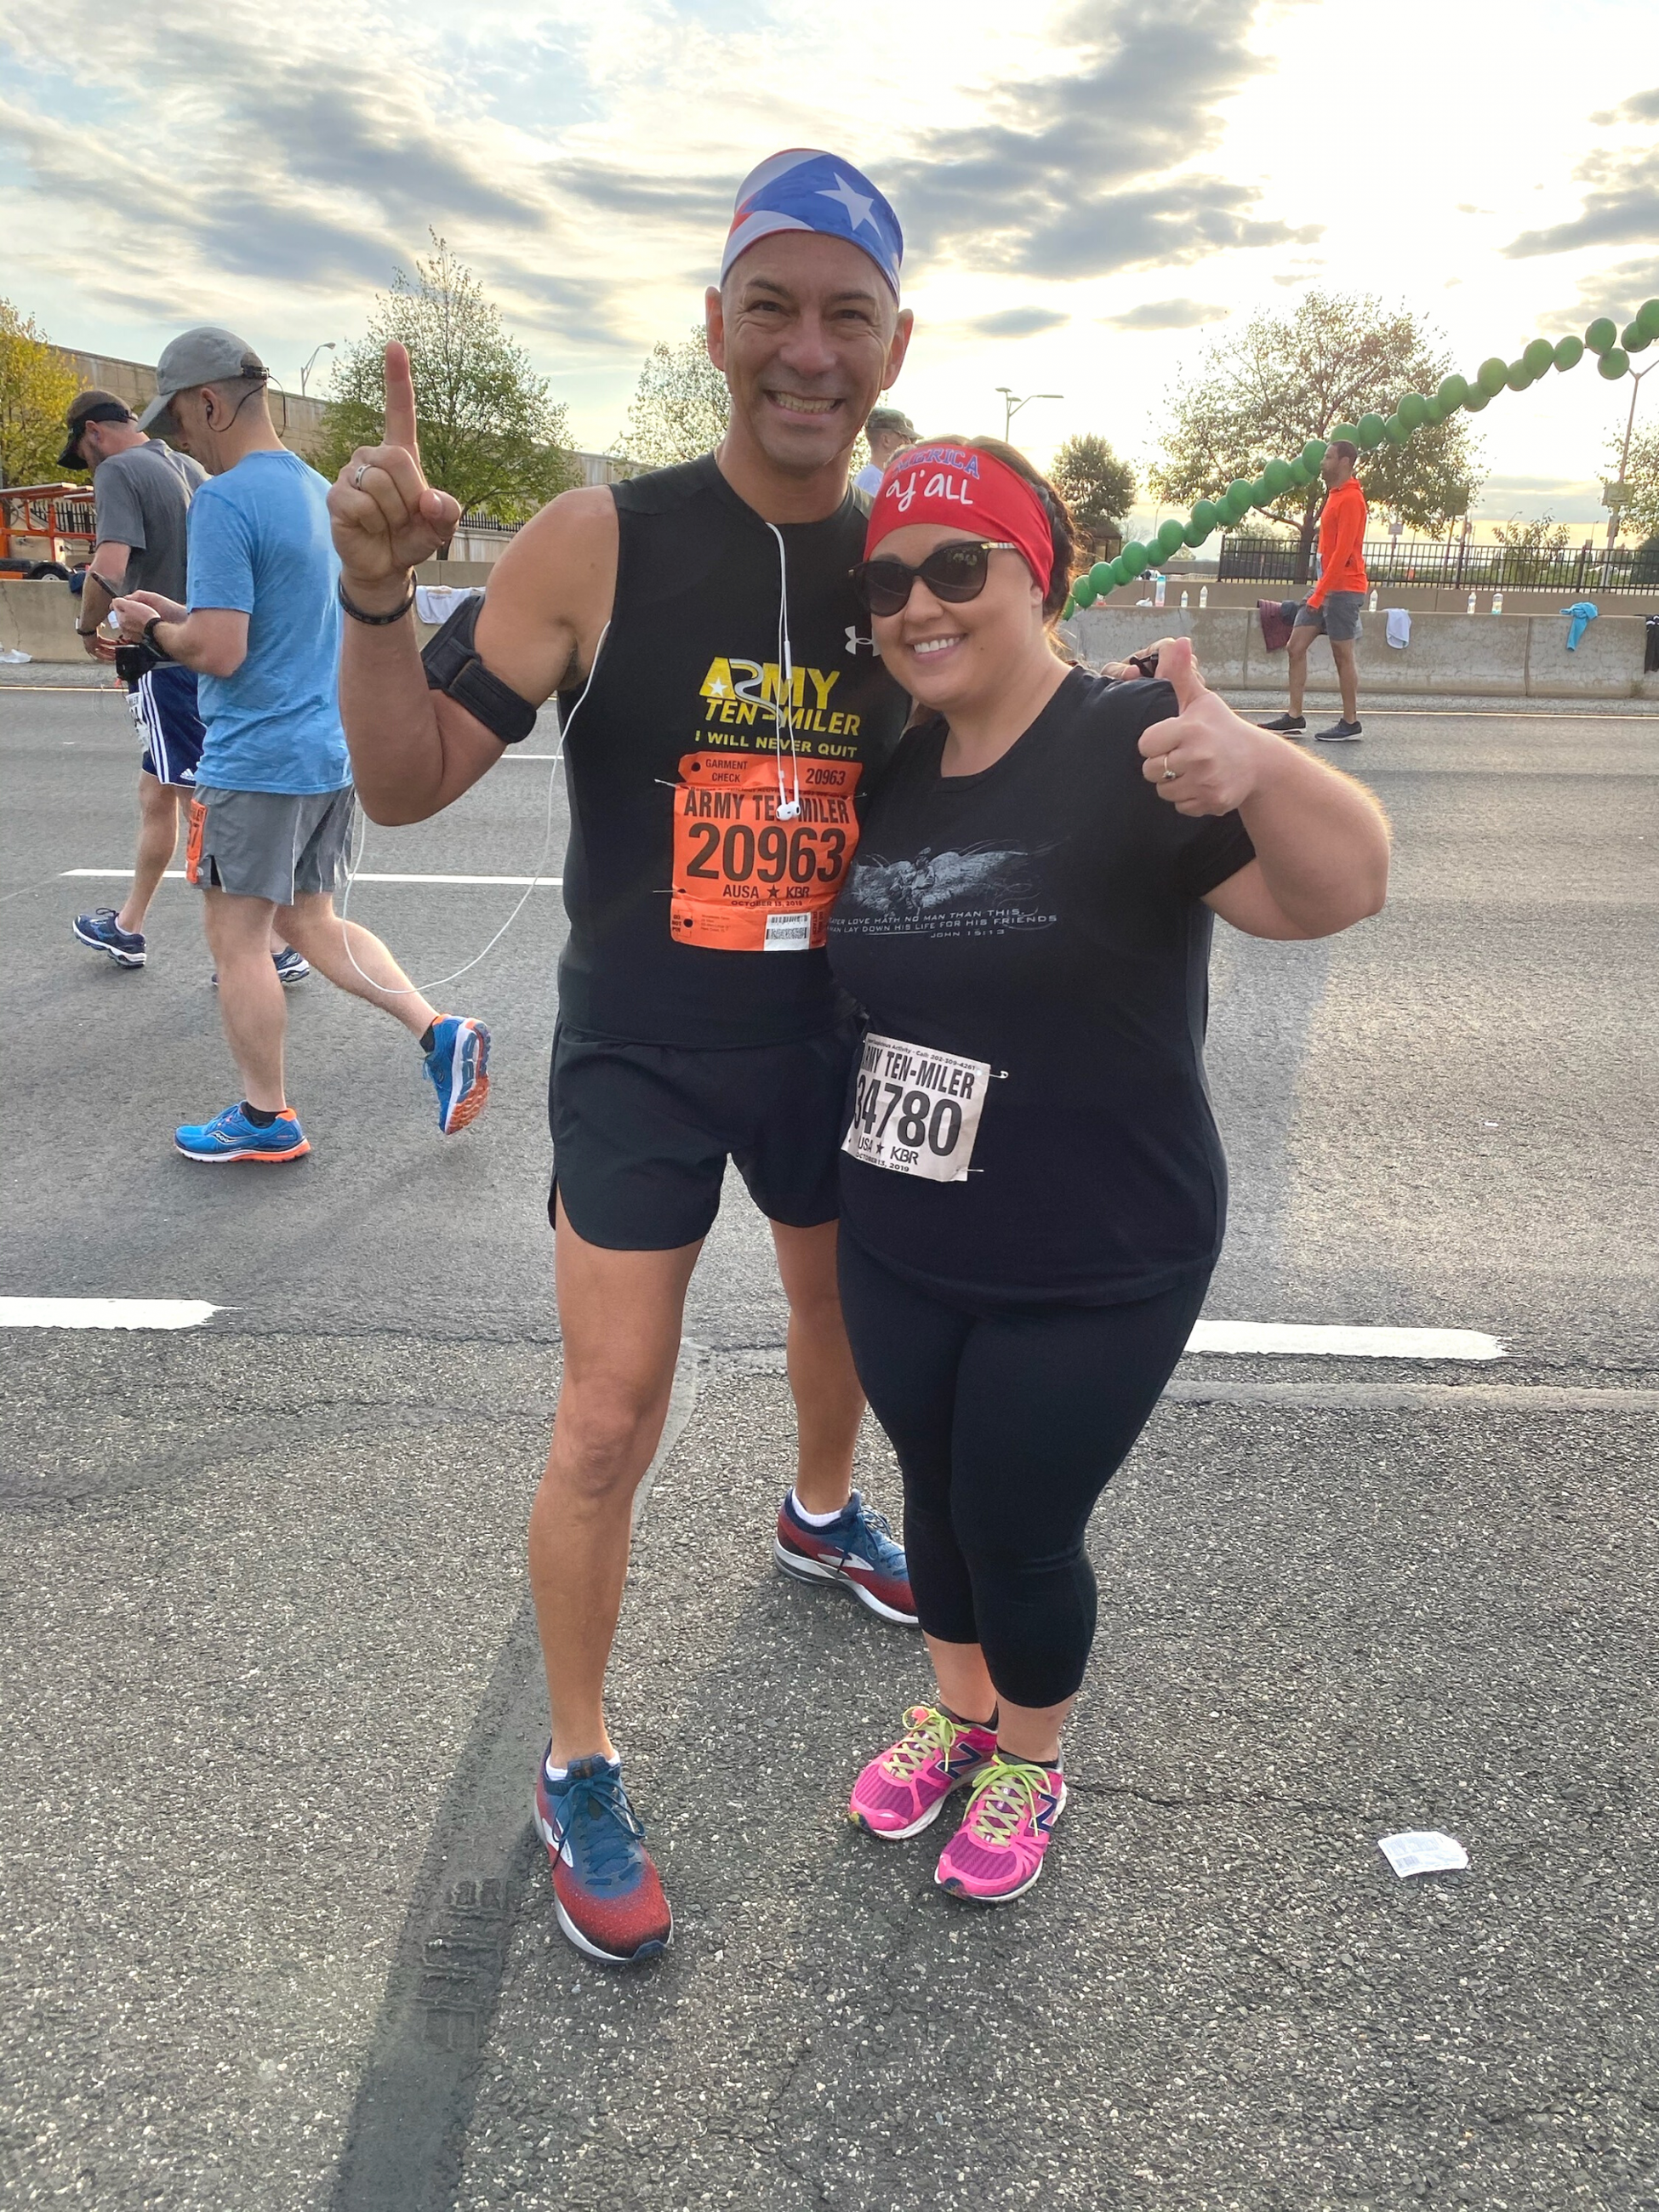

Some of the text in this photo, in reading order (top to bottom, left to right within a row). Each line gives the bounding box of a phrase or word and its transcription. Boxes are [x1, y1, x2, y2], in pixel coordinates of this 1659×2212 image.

[891, 448, 979, 480] MERICA
[698, 657, 841, 710] ARMY
[705, 698, 861, 736] TEN-MILER
[694, 730, 858, 758] I WILL NEVER QUIT
[705, 758, 846, 785] GARMENT 20963
[711, 772, 740, 783] CHECK
[683, 790, 850, 824] ARMY TEMILER
[687, 822, 846, 883] 20963
[722, 884, 810, 898] AUSA KBR
[915, 922, 936, 931] LIFE
[939, 920, 961, 928] FOR
[993, 915, 1058, 926] FRIENDS
[892, 1045, 911, 1055] Activity
[885, 1050, 976, 1100] TEN-MILER
[853, 1074, 962, 1157] 34780
[855, 1151, 878, 1165] OCTOBER
[888, 1162, 910, 1173] 2019
[858, 1135, 920, 1166] USA KBR
